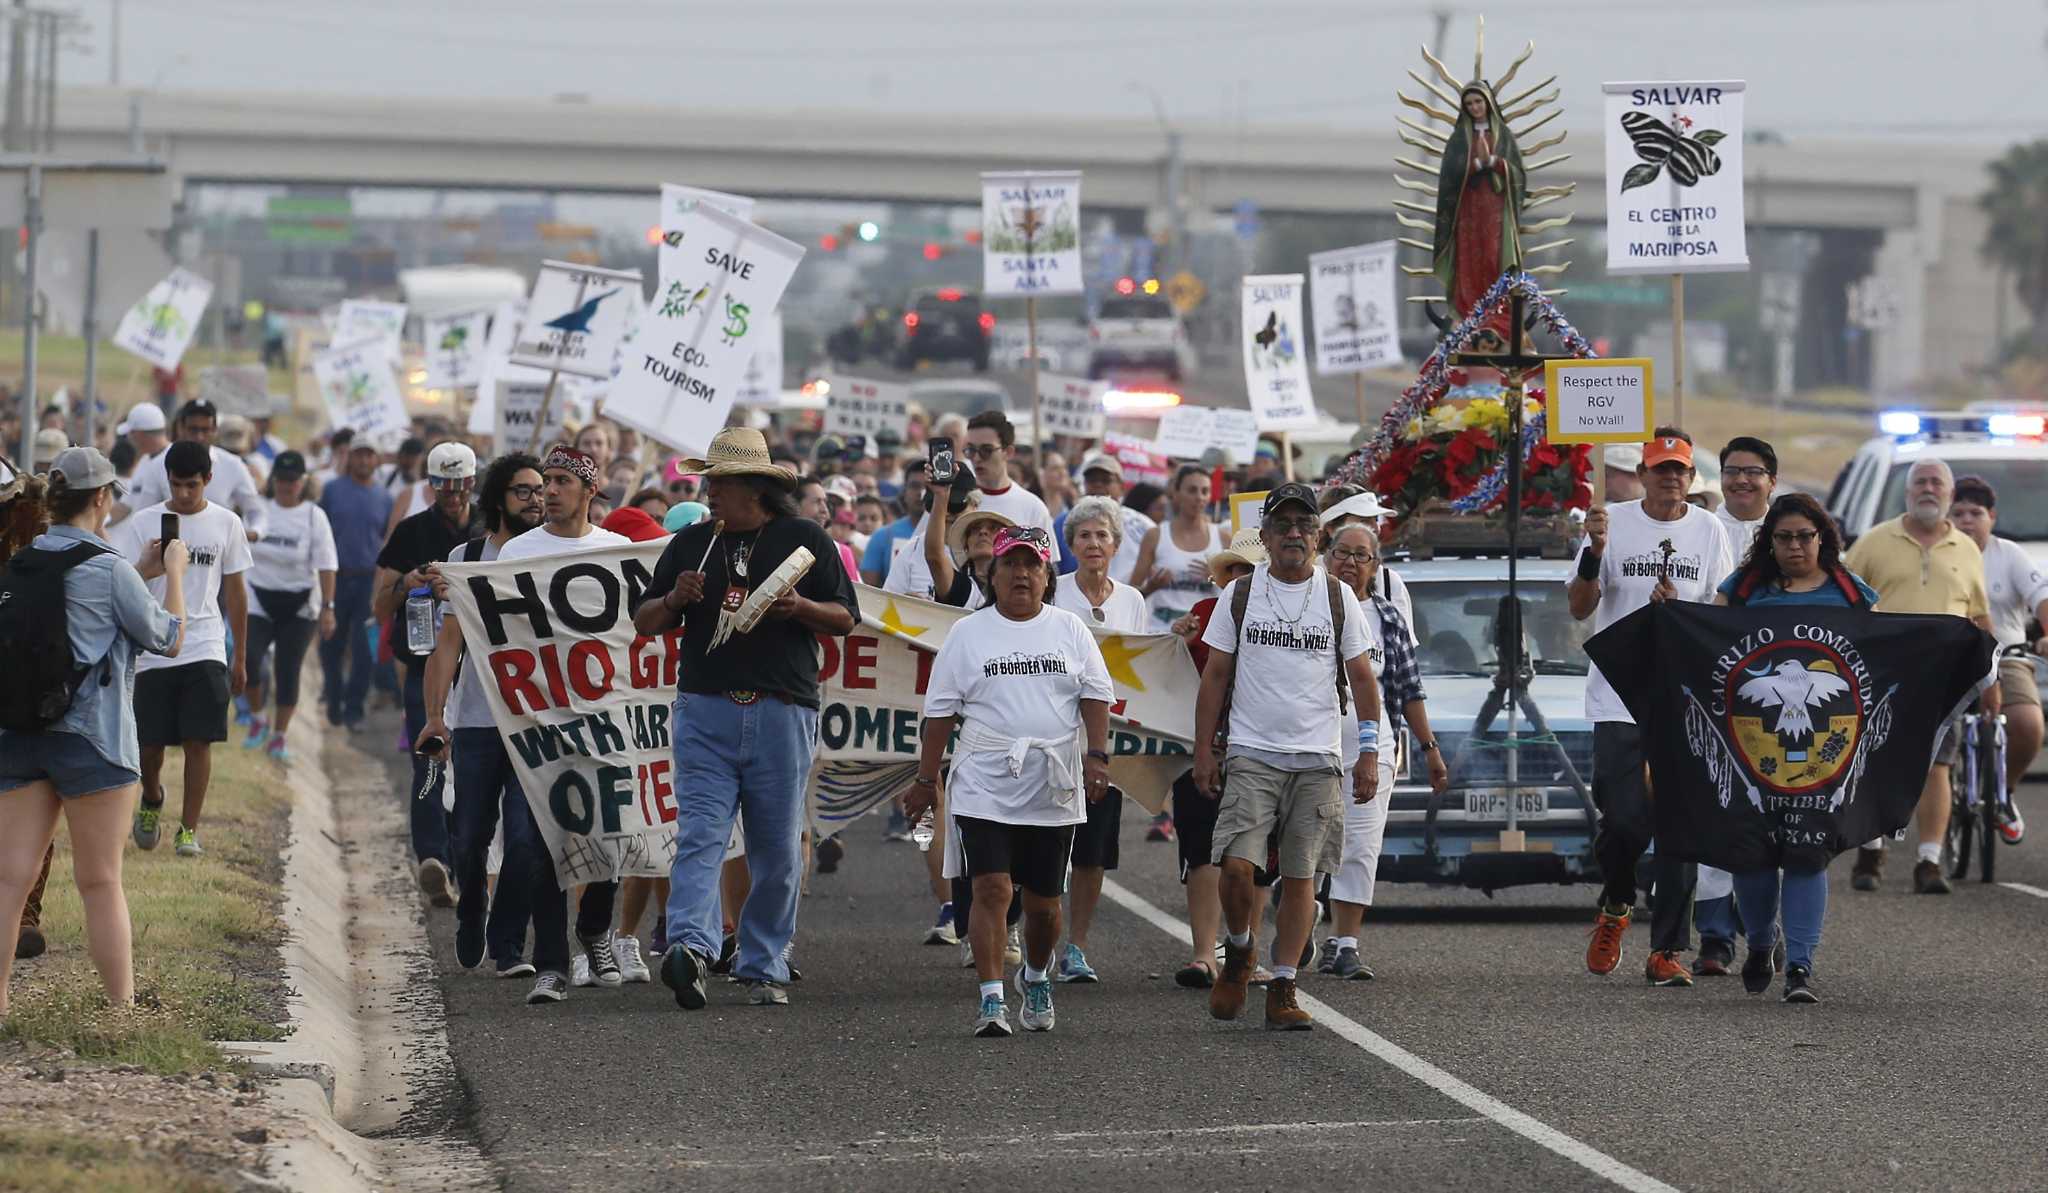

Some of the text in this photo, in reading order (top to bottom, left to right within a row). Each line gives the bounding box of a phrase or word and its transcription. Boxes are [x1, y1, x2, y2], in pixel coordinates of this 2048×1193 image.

[1631, 86, 1722, 106] SALVAR
[1628, 206, 1717, 223] EL CENTRO
[1667, 224, 1701, 237] DE LA
[1629, 240, 1718, 257] MARIPOSA
[705, 246, 755, 281] SAVE
[1003, 257, 1058, 272] SANTA
[1015, 275, 1050, 289] ANA
[671, 341, 710, 370] ECO-
[643, 355, 716, 404] TOURISM
[1563, 373, 1638, 390] Respect the
[1587, 395, 1615, 408] RGV
[1578, 415, 1624, 426] No Wall!
[1622, 561, 1636, 577] NO
[1675, 563, 1699, 582] WALL
[1246, 627, 1259, 645] NO
[1303, 633, 1328, 650] WALL
[488, 639, 615, 716] RIO
[983, 659, 1067, 678] NO BORDER WALL
[1711, 626, 1775, 717] CARRIZO
[1793, 623, 1874, 716] COMECRUDO
[509, 710, 626, 769] WITH
[549, 765, 634, 836] OF
[1766, 794, 1829, 812] TRIBE
[1784, 812, 1805, 825] OF
[1767, 828, 1827, 846] TXAS
